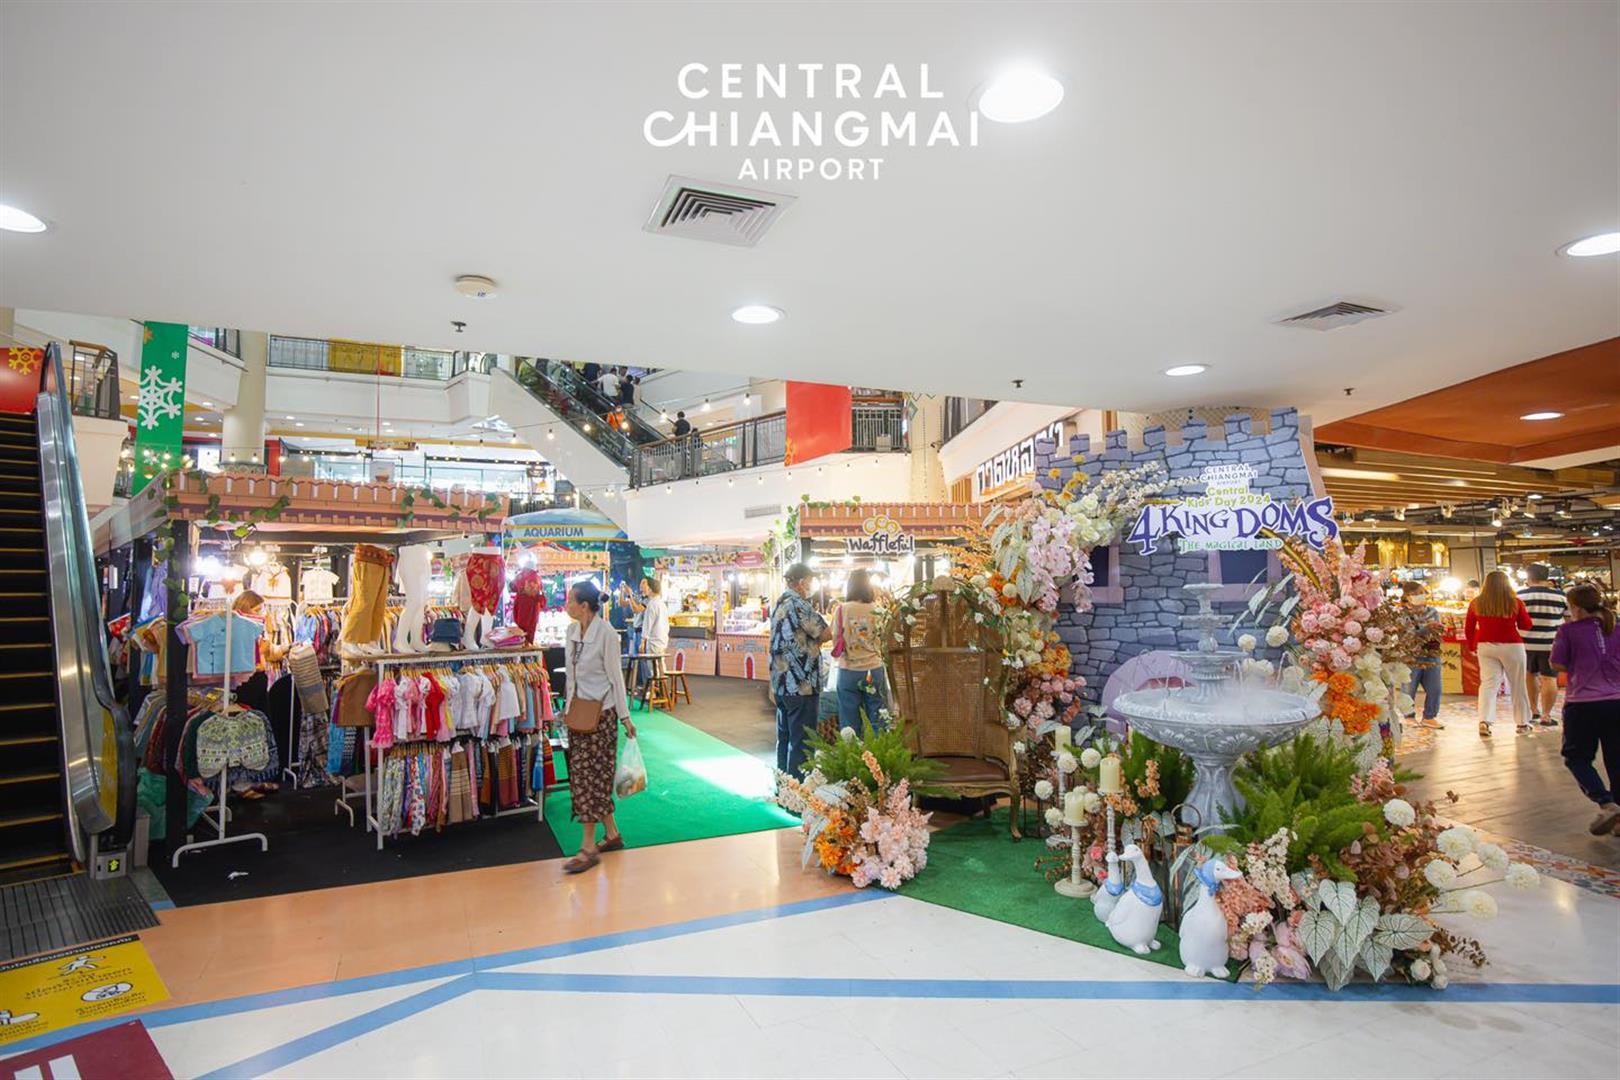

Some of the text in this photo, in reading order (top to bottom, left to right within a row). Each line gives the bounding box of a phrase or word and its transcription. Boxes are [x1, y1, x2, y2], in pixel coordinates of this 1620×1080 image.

[1206, 464, 1250, 474] CENTRAL
[1201, 471, 1257, 482] CHIANGMAI
[1207, 485, 1248, 496] Central
[1214, 497, 1237, 507] Day
[1240, 494, 1271, 505] 2024
[523, 527, 584, 538] AQUARIUM
[848, 532, 914, 552] Waffleful
